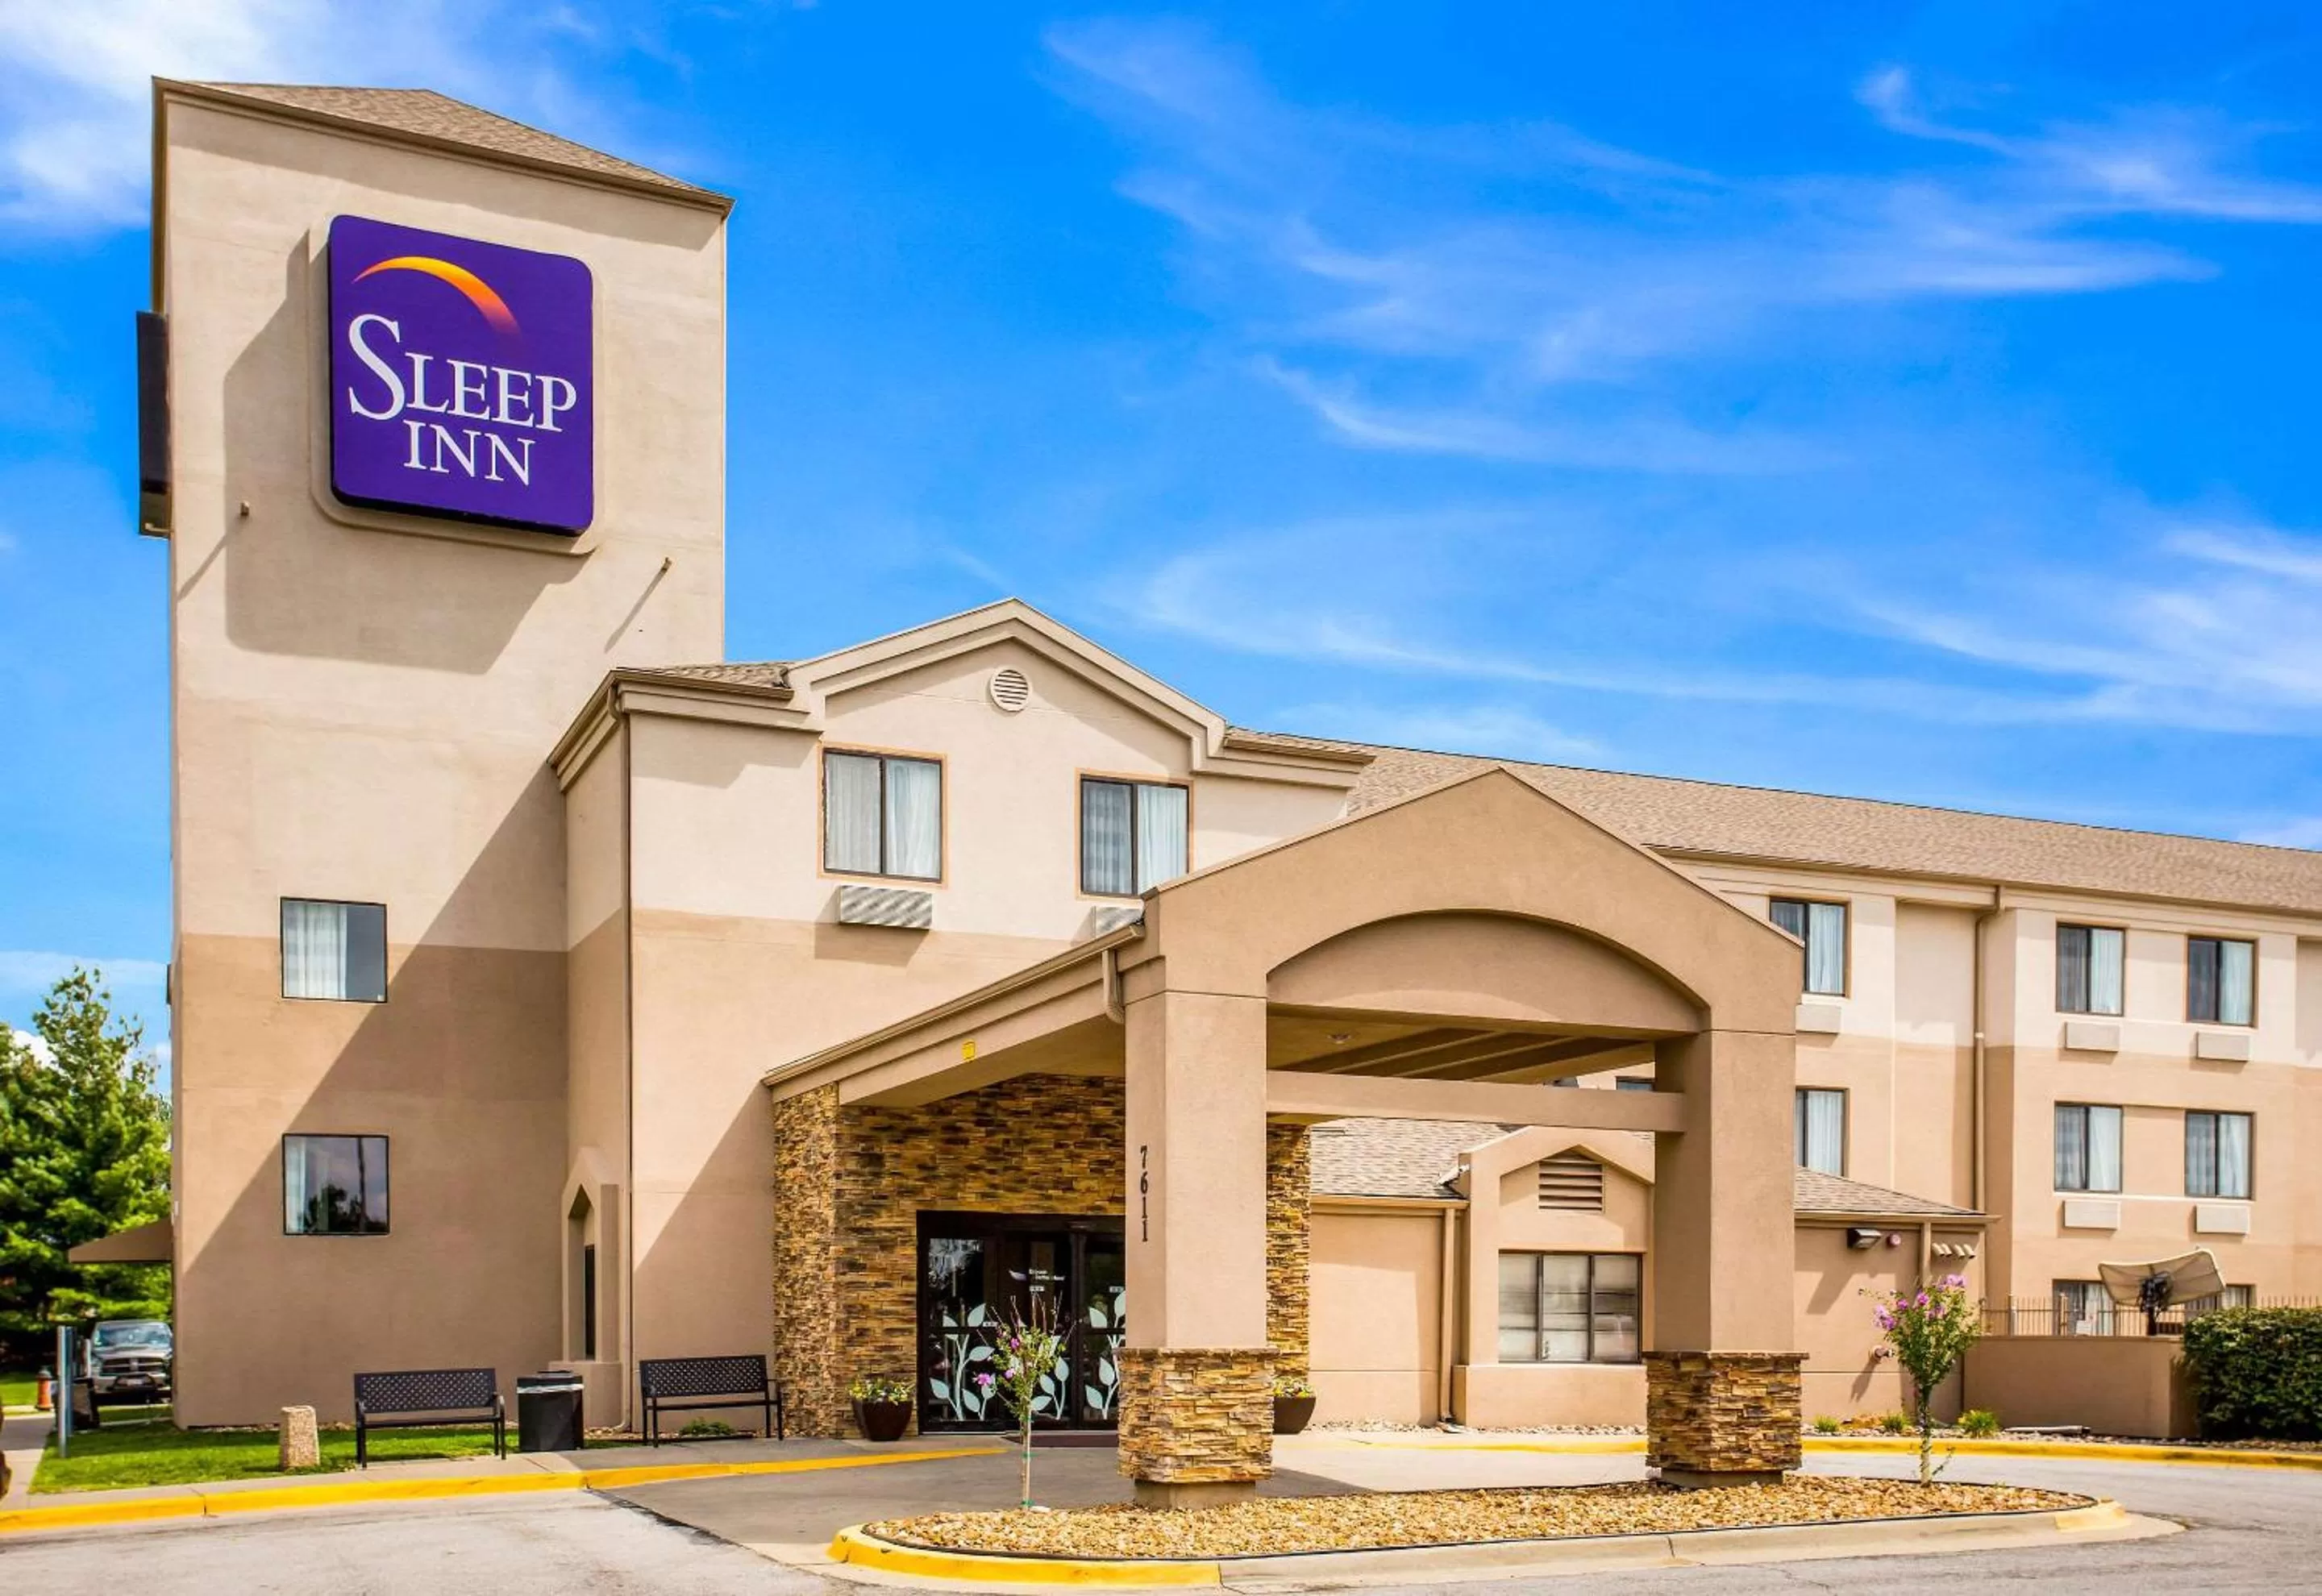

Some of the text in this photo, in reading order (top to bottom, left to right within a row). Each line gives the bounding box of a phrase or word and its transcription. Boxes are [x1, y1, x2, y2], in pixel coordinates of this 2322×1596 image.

[348, 314, 576, 432] SLEEP
[403, 419, 535, 486] INN
[1140, 1145, 1148, 1242] 7611
